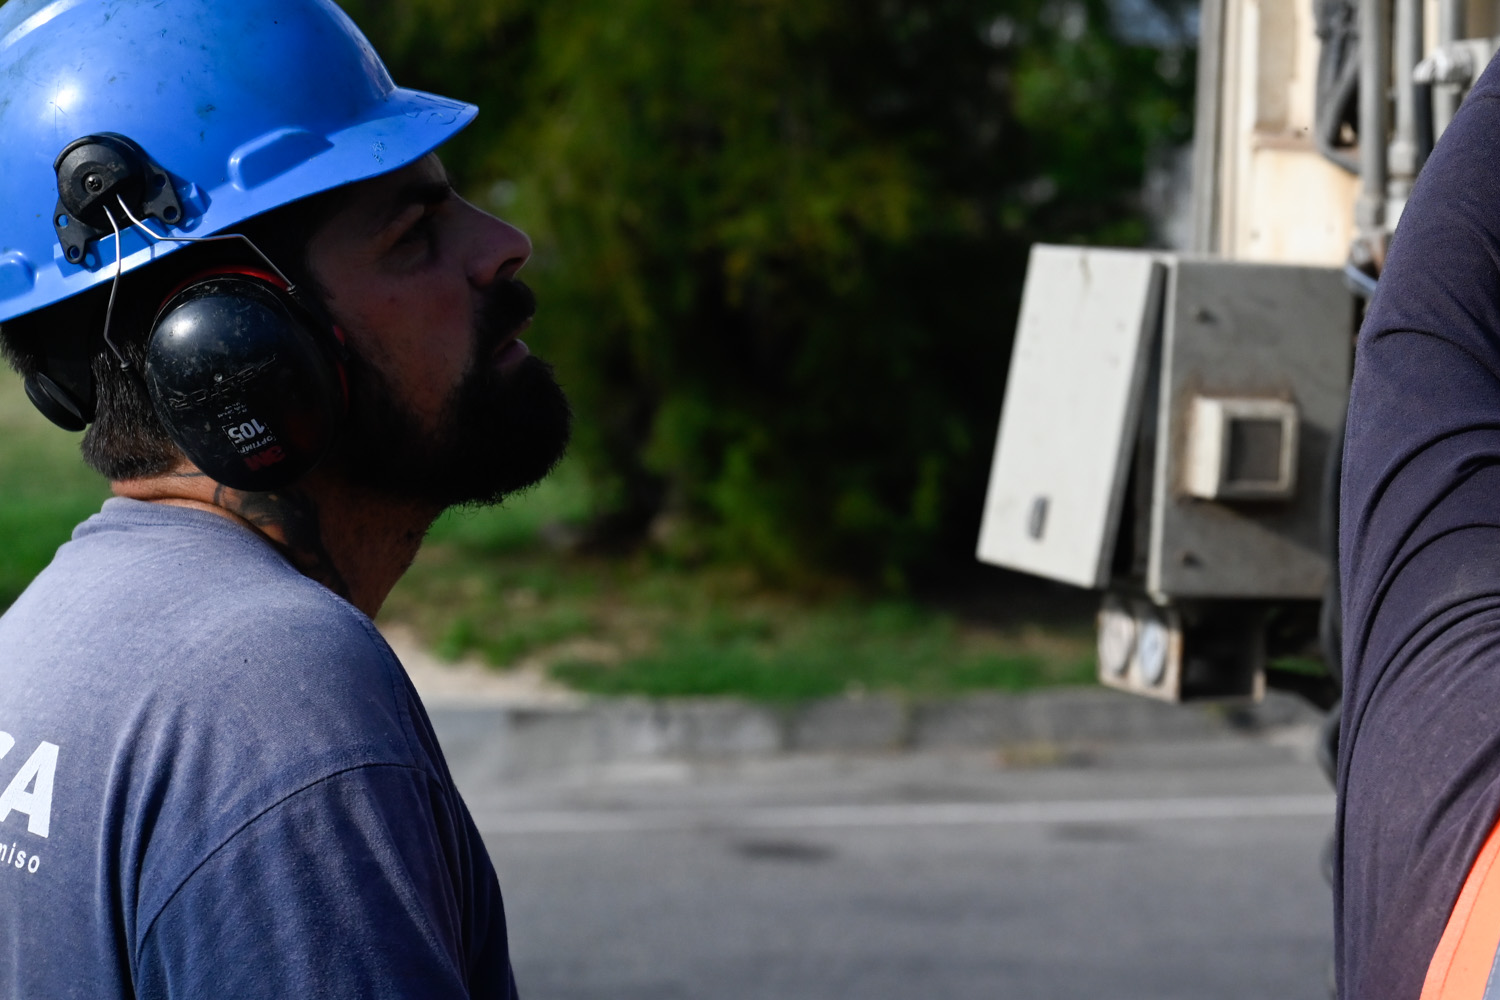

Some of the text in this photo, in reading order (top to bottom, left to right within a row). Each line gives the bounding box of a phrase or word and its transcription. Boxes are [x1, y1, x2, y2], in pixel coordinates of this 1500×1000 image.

[227, 418, 266, 444] 105
[244, 446, 286, 471] 3M
[0, 730, 60, 838] A
